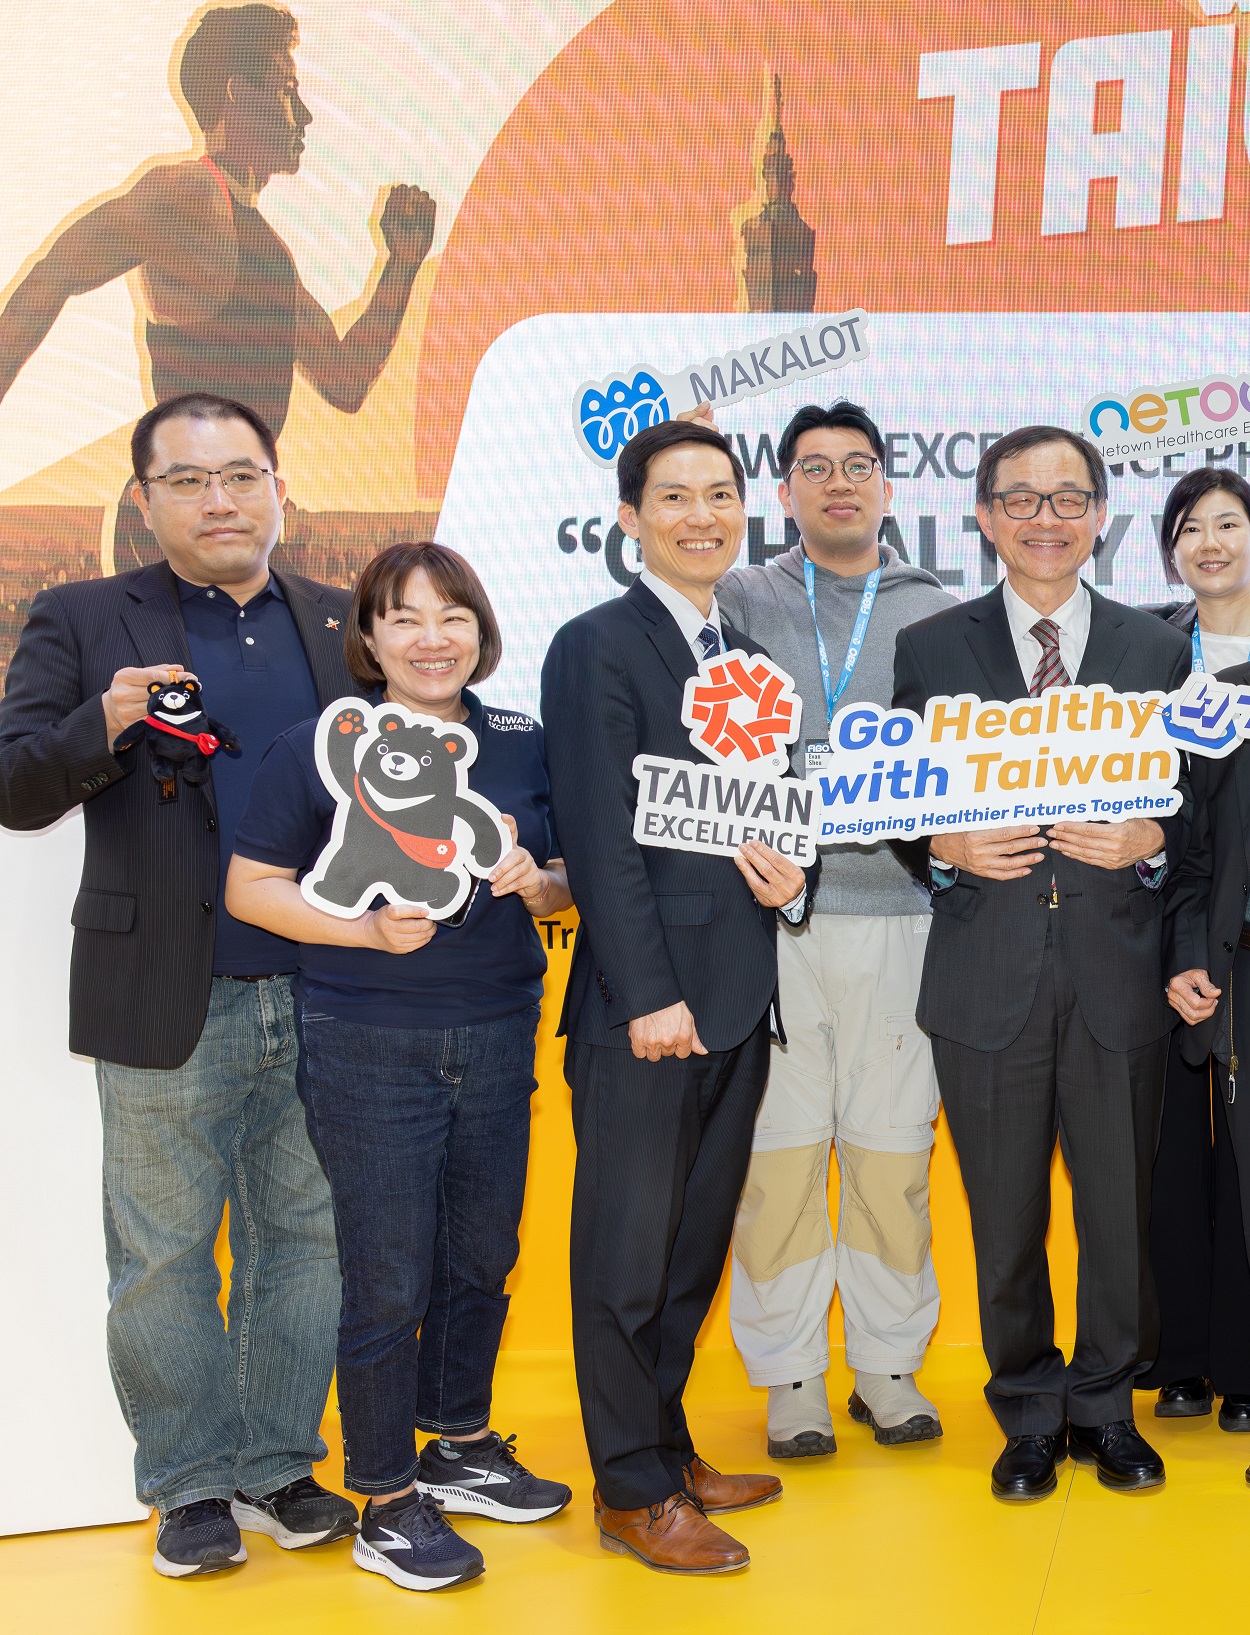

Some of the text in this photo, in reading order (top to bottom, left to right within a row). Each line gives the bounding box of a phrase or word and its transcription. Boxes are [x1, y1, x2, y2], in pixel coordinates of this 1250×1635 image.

[689, 316, 862, 405] MAKALOT
[1156, 424, 1238, 448] Healthcare
[861, 591, 875, 615] FIBO
[845, 647, 858, 673] FIBO
[487, 712, 534, 725] TAIWAN
[488, 720, 534, 732] EXCELLENCE
[838, 691, 1160, 751] Go Healthy
[807, 744, 830, 753] FIBO
[818, 747, 1172, 807] with Taiwan
[643, 764, 813, 827] TAIWAN
[821, 796, 1174, 837] Designing Healthier Futures Together
[643, 811, 809, 858] EXCELLENCE
